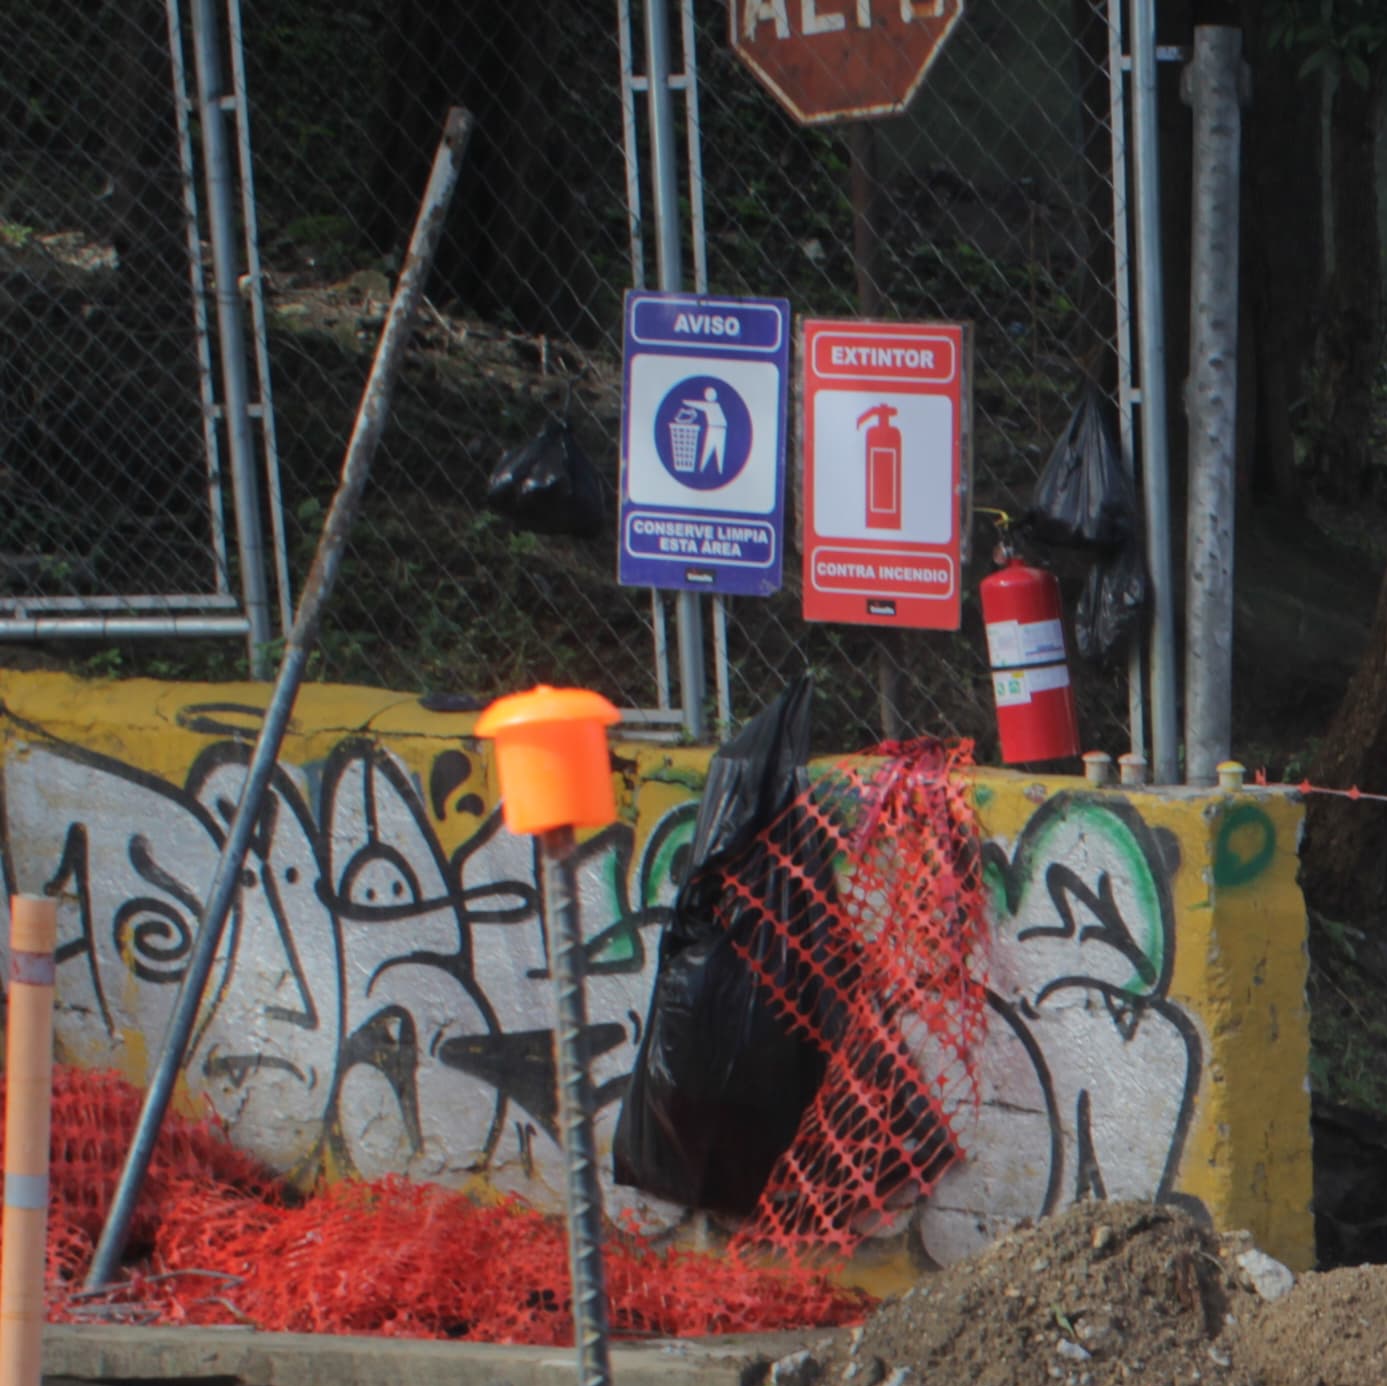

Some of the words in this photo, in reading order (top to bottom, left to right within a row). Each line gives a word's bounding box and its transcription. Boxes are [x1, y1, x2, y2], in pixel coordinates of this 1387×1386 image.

[674, 313, 741, 336] AVISO
[831, 346, 934, 369] EXTINTOR
[633, 519, 714, 540] CONSERVE
[717, 526, 769, 544] LIMPIA
[659, 537, 698, 554] ESTA
[816, 562, 876, 579] CONTRA
[879, 566, 949, 584] INCENDIO
